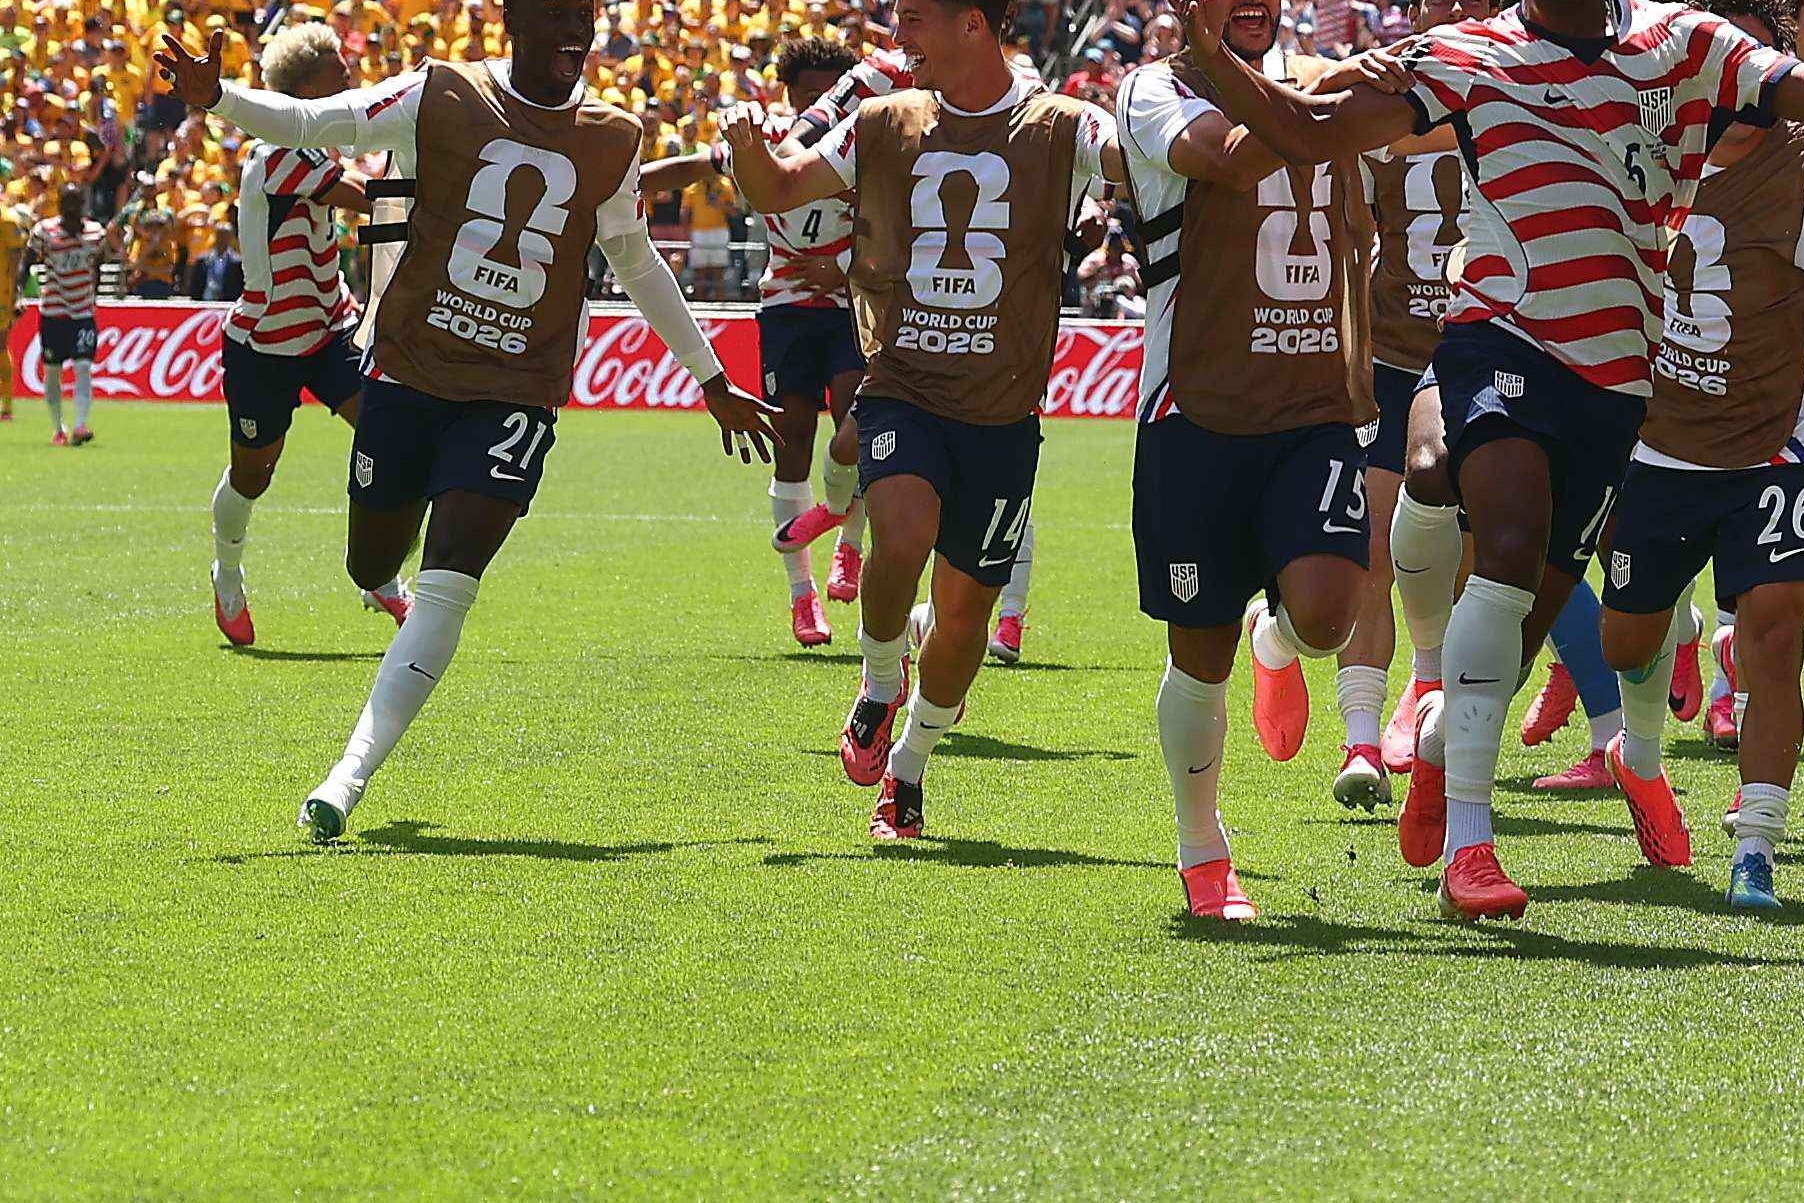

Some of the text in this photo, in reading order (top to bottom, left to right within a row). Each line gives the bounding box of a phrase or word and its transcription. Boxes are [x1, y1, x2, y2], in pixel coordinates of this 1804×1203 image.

[1638, 88, 1669, 110] USA
[801, 208, 823, 244] 4
[473, 264, 521, 295] FIFA
[932, 276, 976, 295] FIFA
[1285, 264, 1321, 284] FIFA
[435, 289, 534, 332] WORLD CUP
[901, 307, 999, 330] WORLD CUP
[1254, 307, 1334, 325] WORLD CUP
[77, 328, 96, 347] 20
[426, 306, 528, 355] 2026
[895, 326, 995, 354] 2026
[1250, 326, 1339, 355] 2026
[1658, 341, 1731, 376] ORLD CUP
[1653, 357, 1728, 397] 026
[487, 410, 547, 471] 21
[1317, 459, 1367, 521] 15
[981, 498, 1031, 551] 14
[1171, 564, 1198, 581] USA
[1613, 551, 1630, 570] USA
